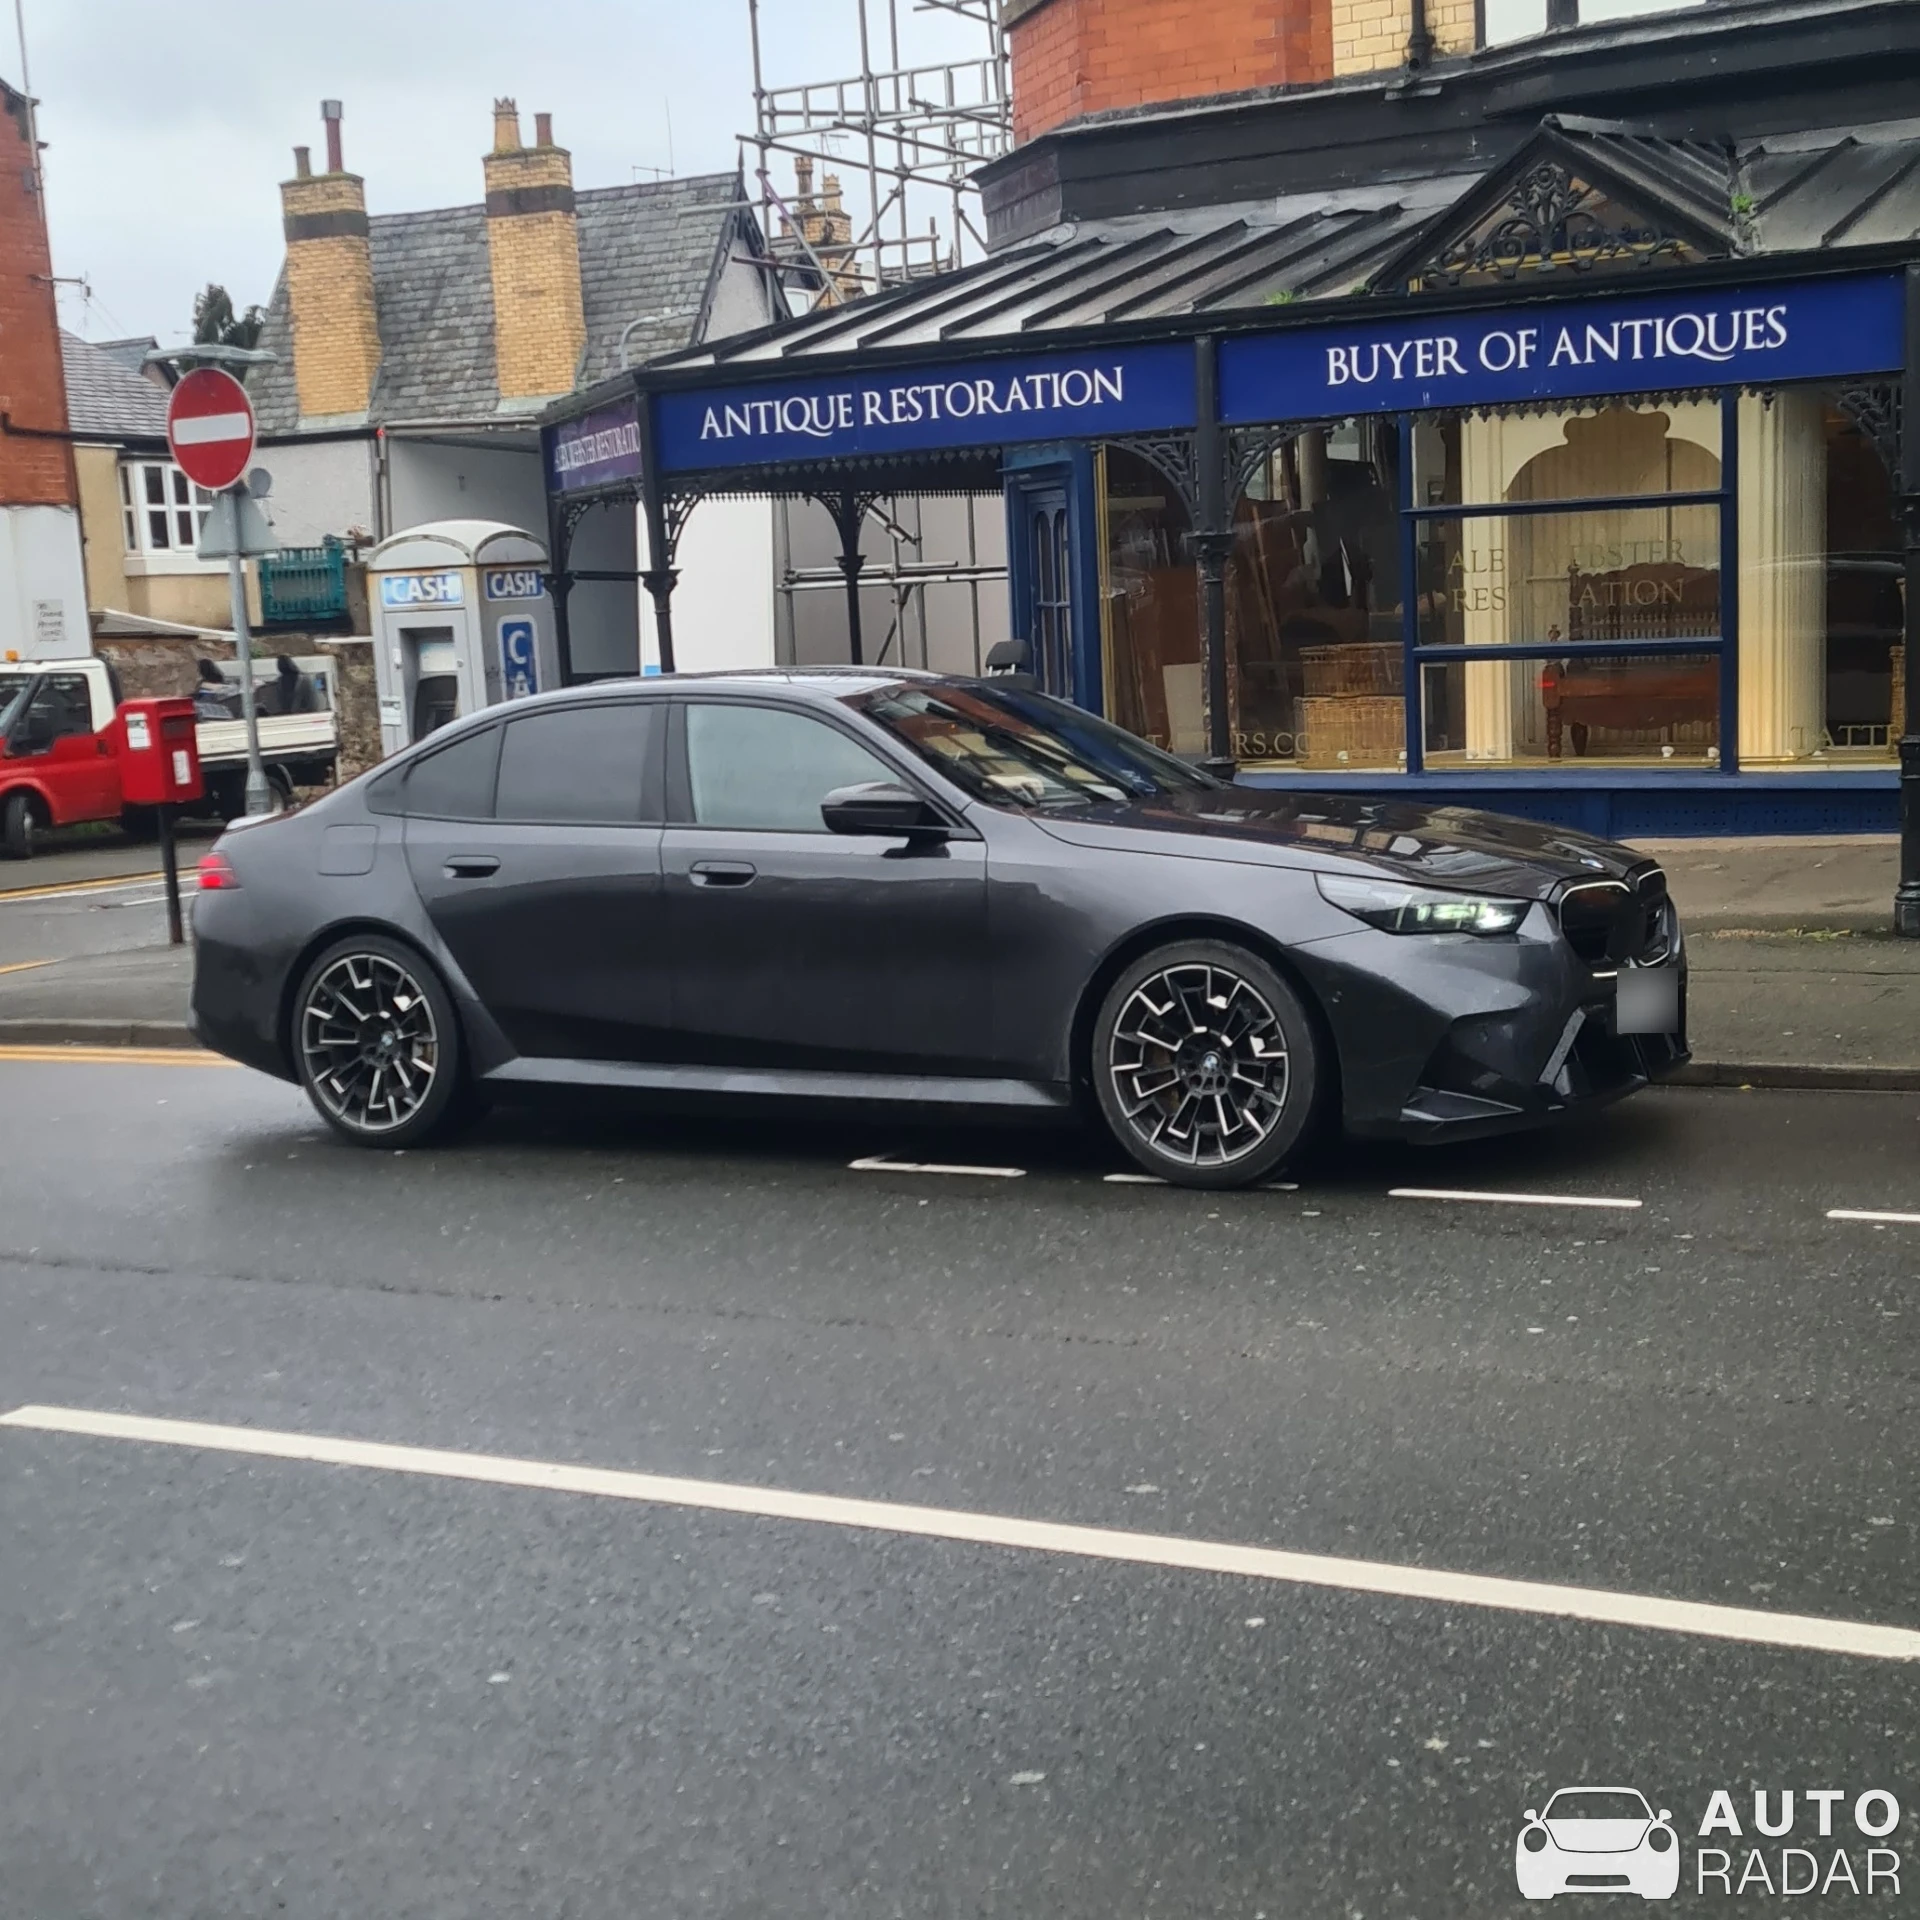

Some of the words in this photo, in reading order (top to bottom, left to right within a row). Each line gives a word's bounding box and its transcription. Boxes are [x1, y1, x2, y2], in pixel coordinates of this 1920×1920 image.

[1326, 336, 1468, 386] BUYER
[1478, 327, 1538, 372] OF
[1548, 304, 1788, 367] ANTIQUES
[700, 393, 854, 437] ANTIQUE
[862, 366, 1124, 426] RESTORATION
[1449, 547, 1511, 575] ALE
[391, 576, 452, 602] CASH
[491, 571, 538, 598] CASH
[1451, 578, 1684, 613] RESATION
